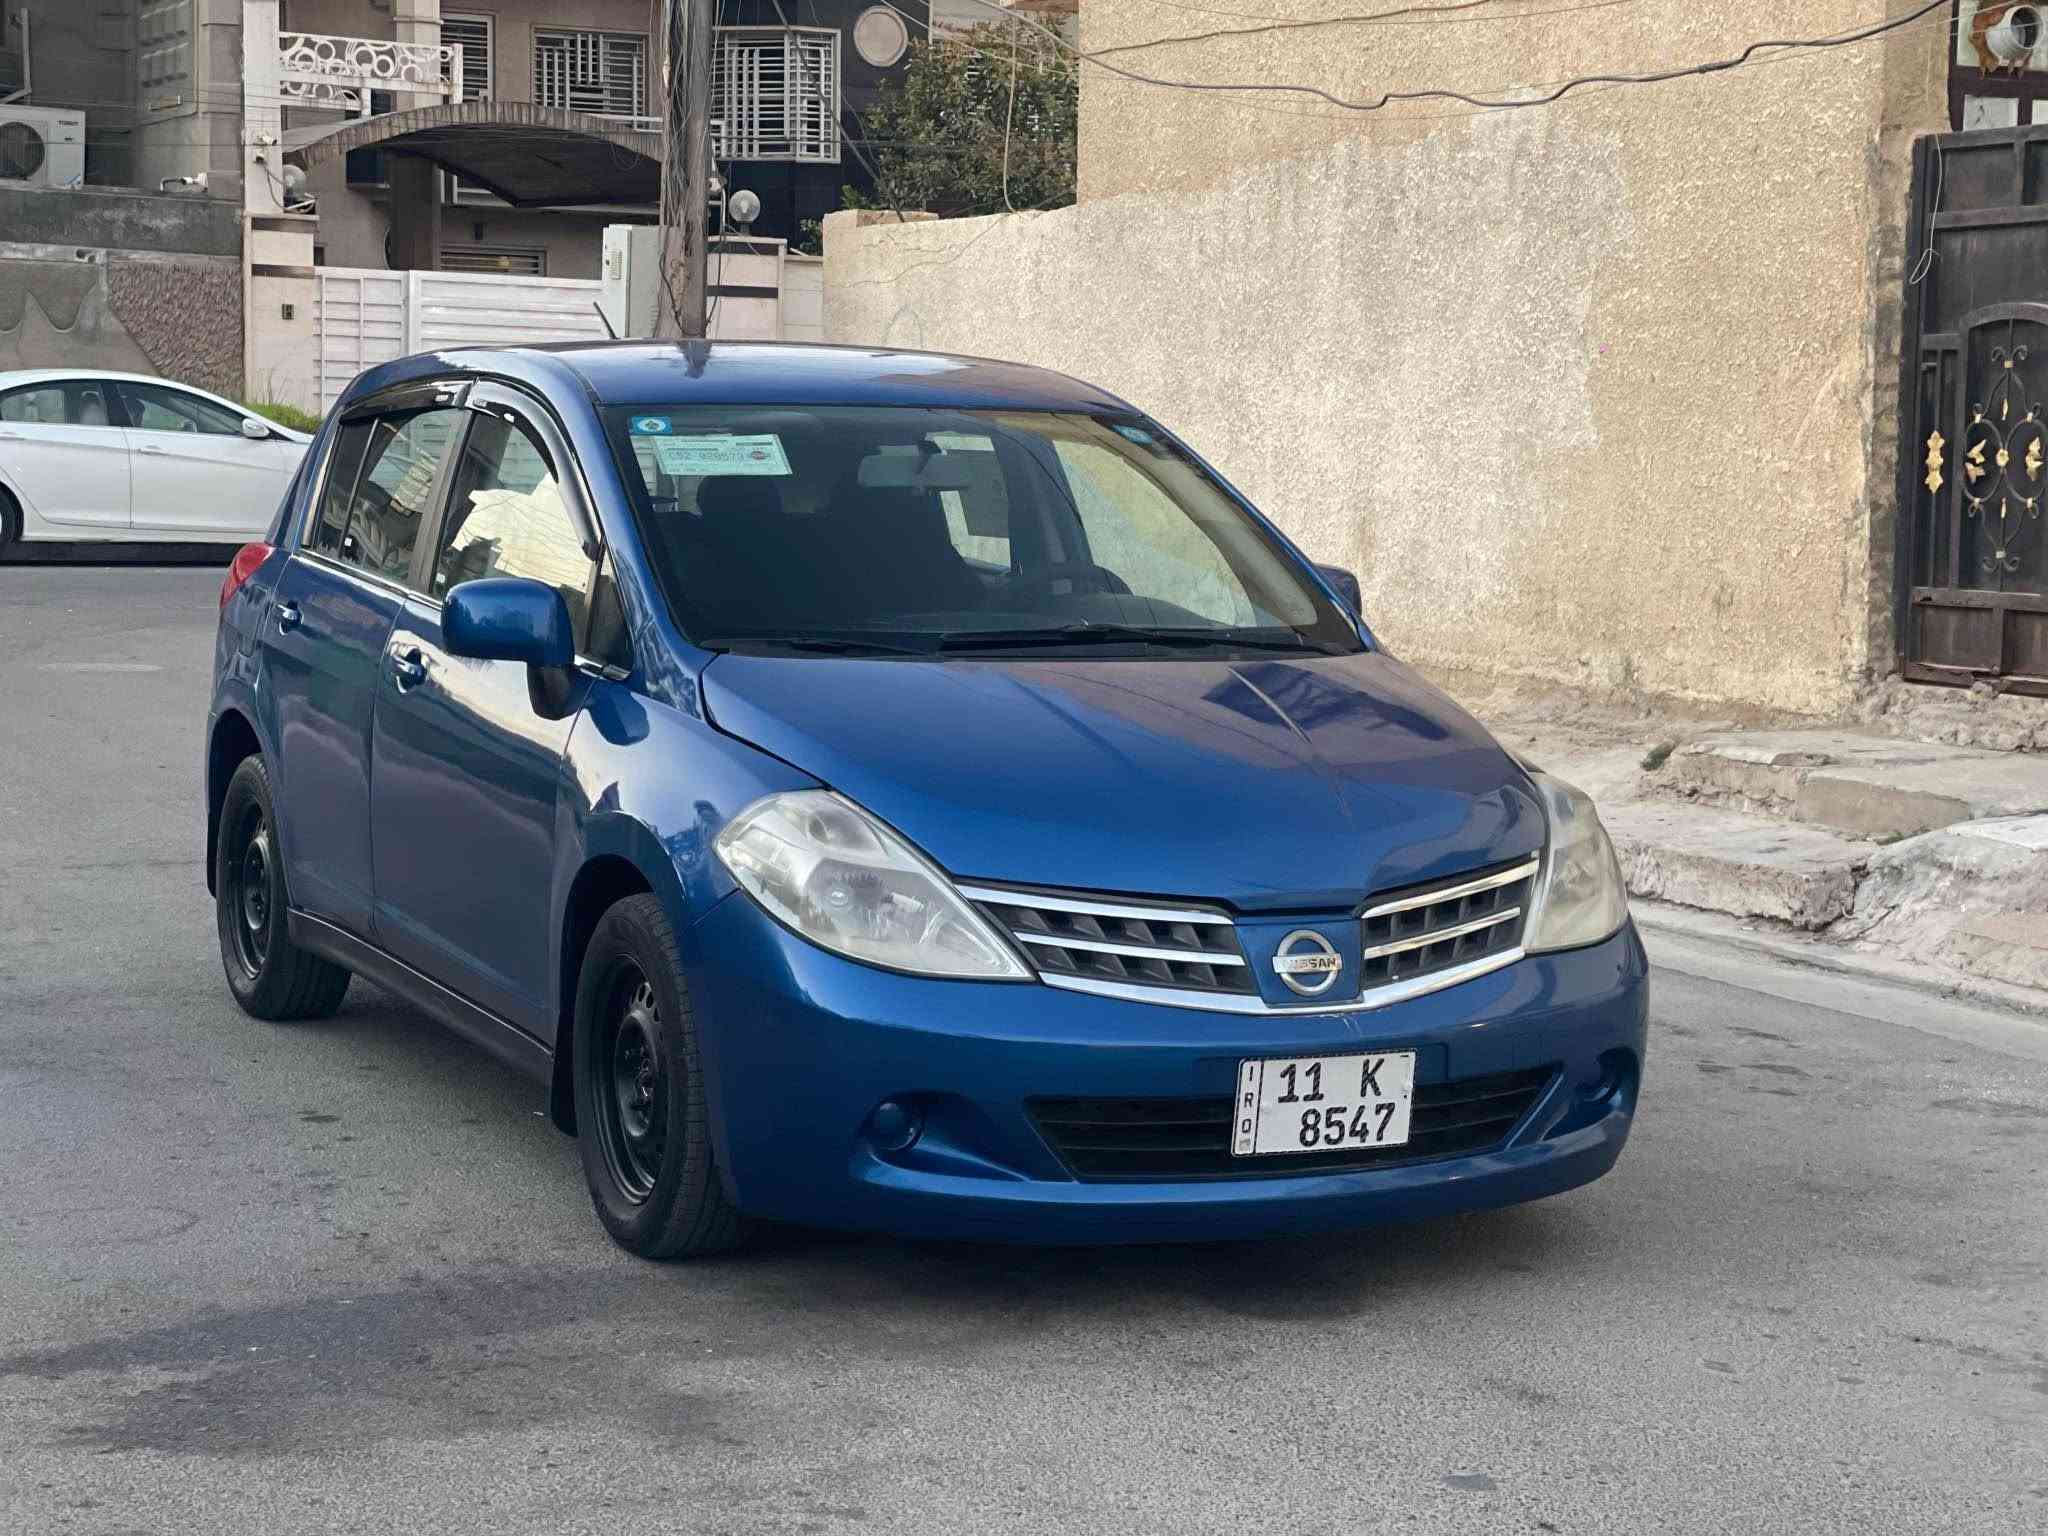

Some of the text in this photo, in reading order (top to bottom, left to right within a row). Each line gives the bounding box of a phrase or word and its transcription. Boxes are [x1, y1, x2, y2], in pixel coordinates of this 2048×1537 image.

[1278, 1058, 1385, 1103] 11 K
[1299, 1102, 1396, 1147] 8547
